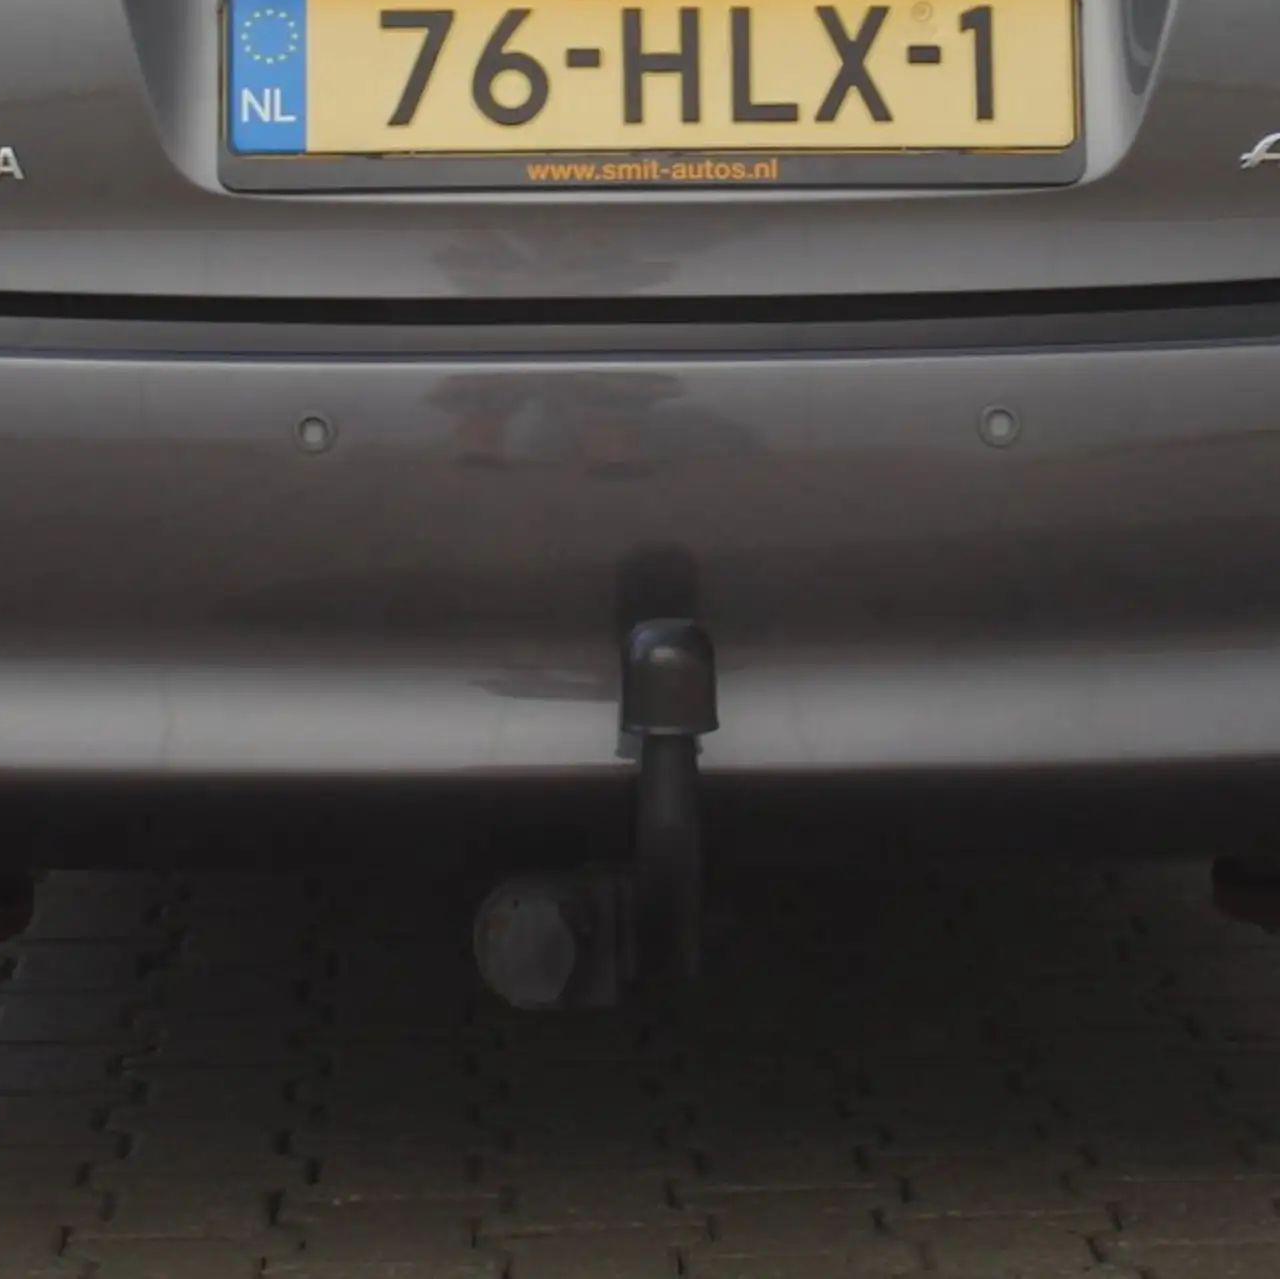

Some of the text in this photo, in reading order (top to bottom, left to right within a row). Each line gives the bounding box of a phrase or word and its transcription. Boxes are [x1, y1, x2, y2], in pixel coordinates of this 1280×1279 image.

[378, 3, 996, 128] 76-HLX-1
[241, 88, 296, 124] NL
[527, 159, 778, 184] www.smit-autos.nl
